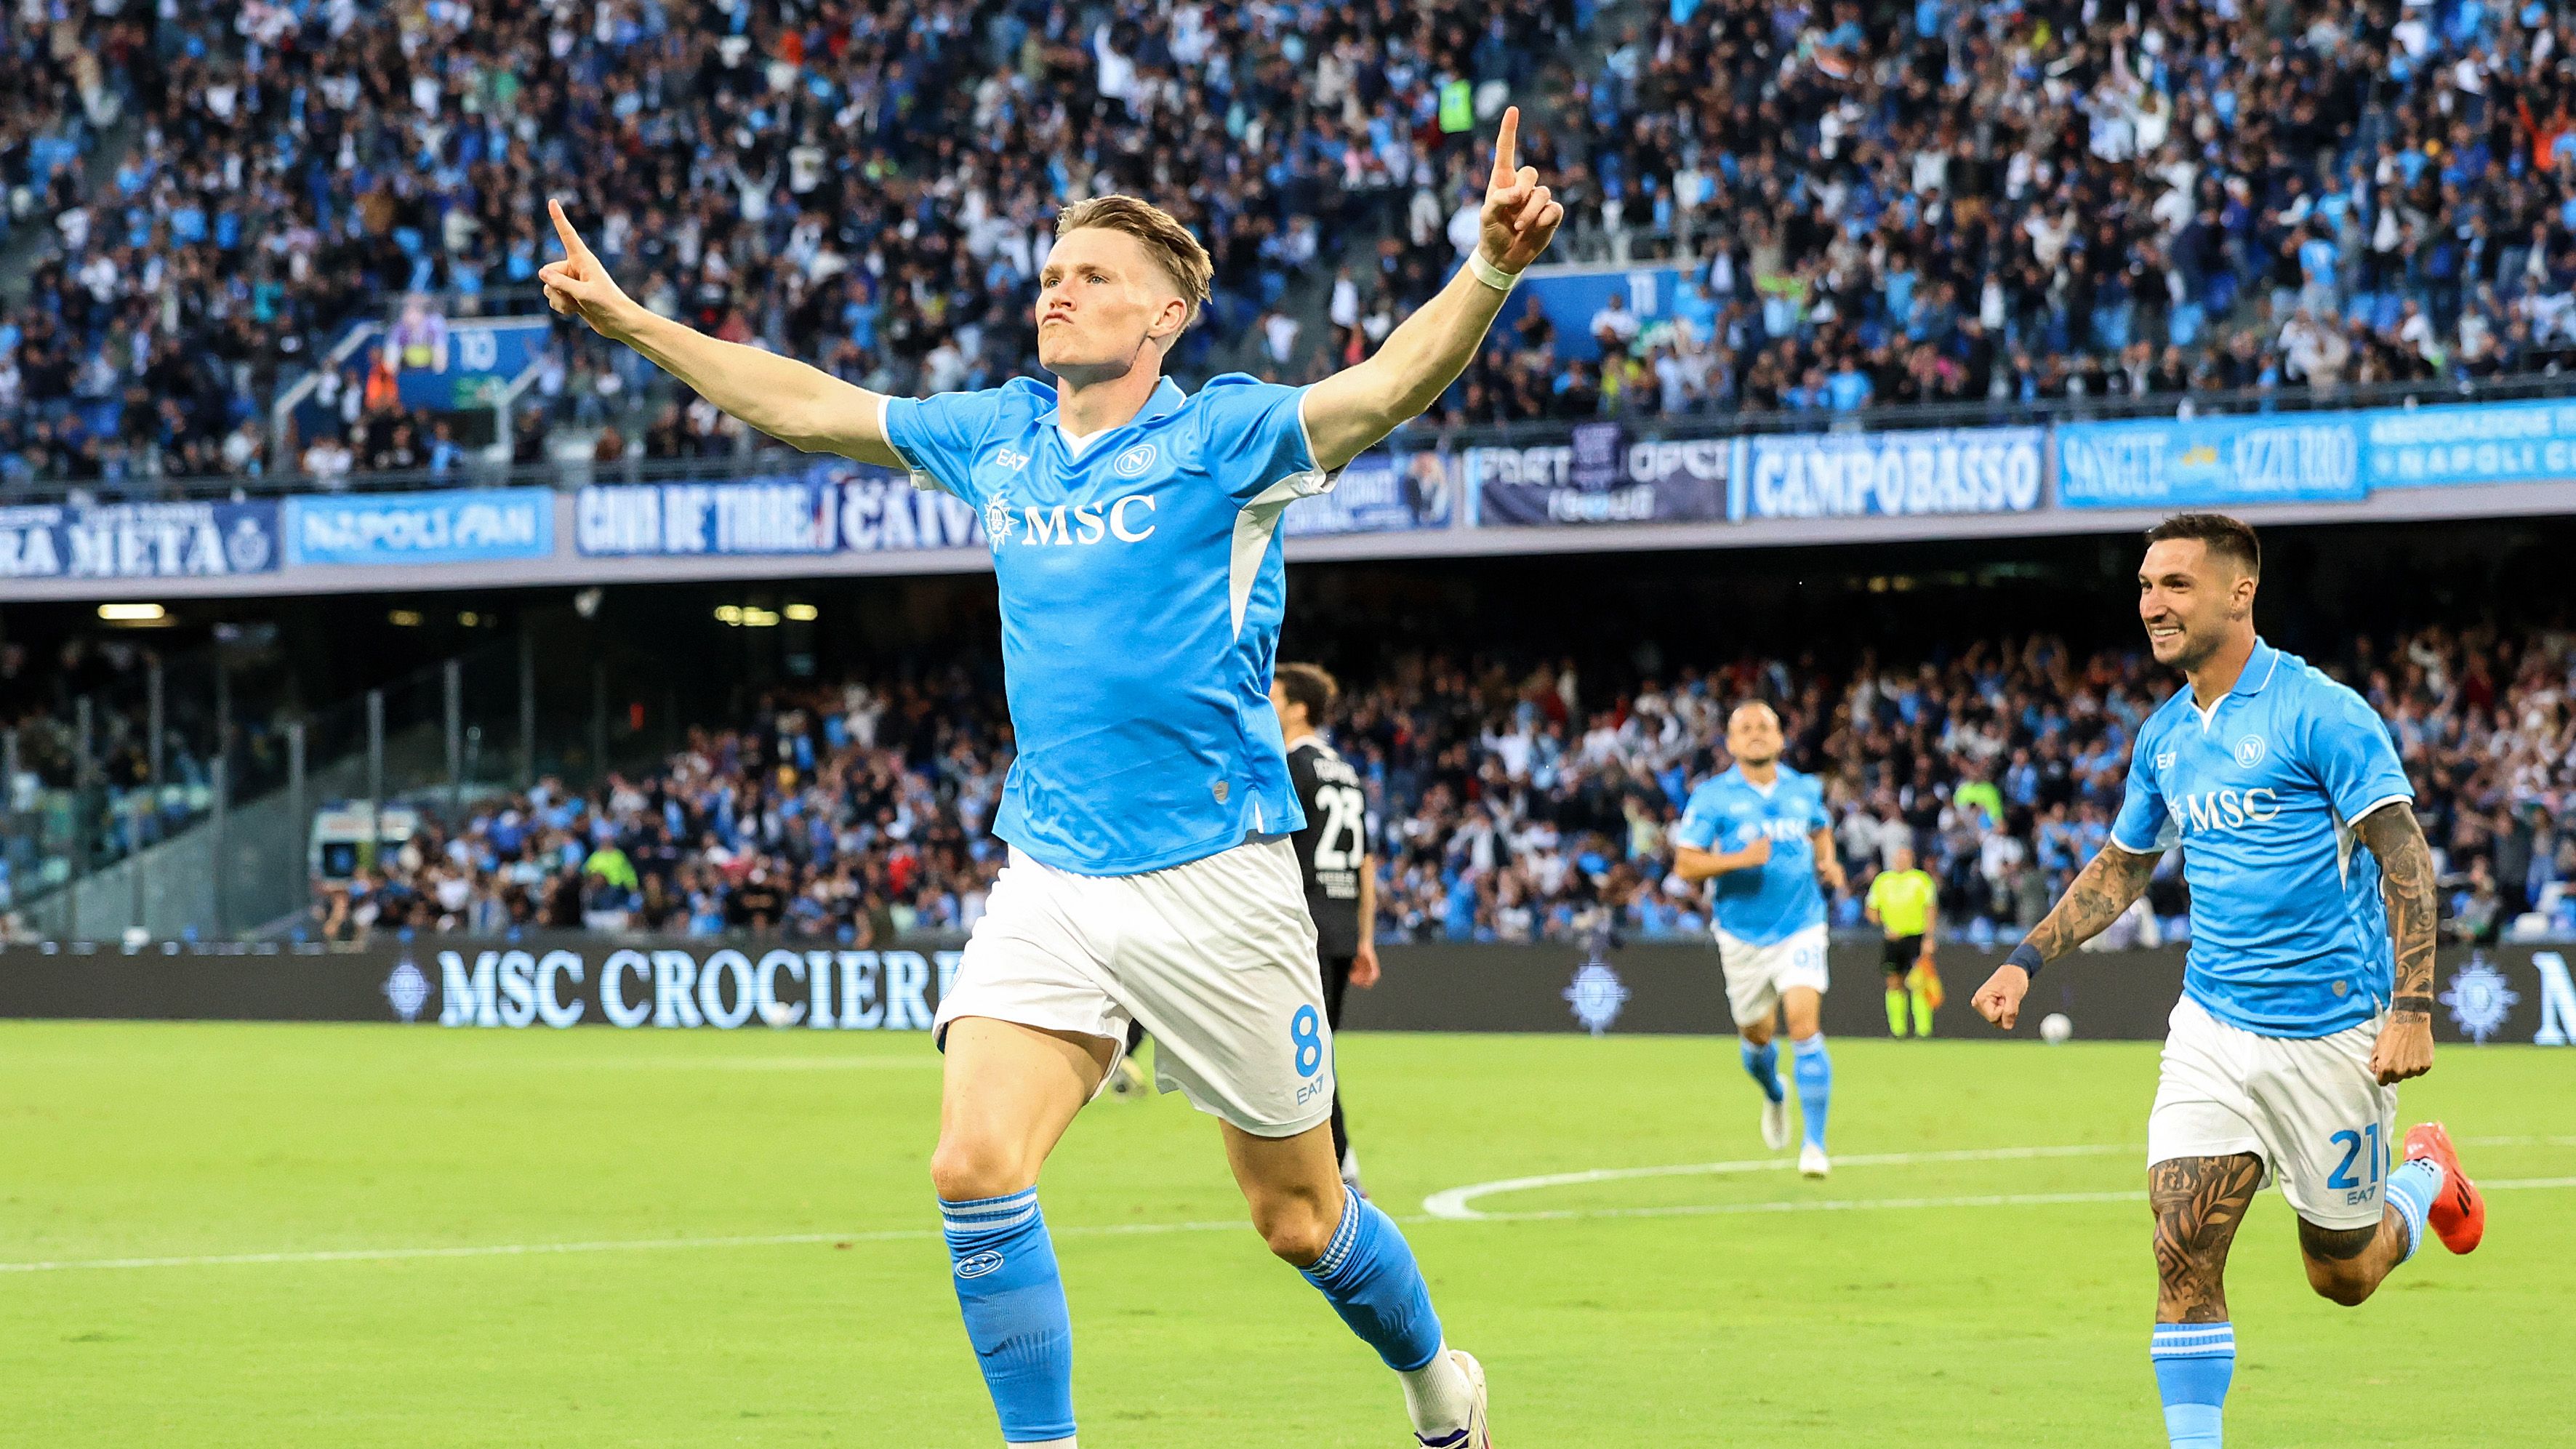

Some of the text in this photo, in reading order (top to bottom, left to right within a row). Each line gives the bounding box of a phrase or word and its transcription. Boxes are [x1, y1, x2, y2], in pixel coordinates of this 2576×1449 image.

[996, 449, 1030, 471] EA7
[1753, 447, 2039, 516] CAMPOBASSO
[840, 477, 990, 551] CAIV
[1021, 494, 1156, 545] MSC
[2186, 787, 2281, 832] MSC
[438, 949, 585, 1028] MSC
[1291, 1003, 1322, 1077] 8
[1296, 1073, 1324, 1106] EA7
[2327, 1123, 2378, 1189] 21
[2347, 1185, 2376, 1205] EA7
